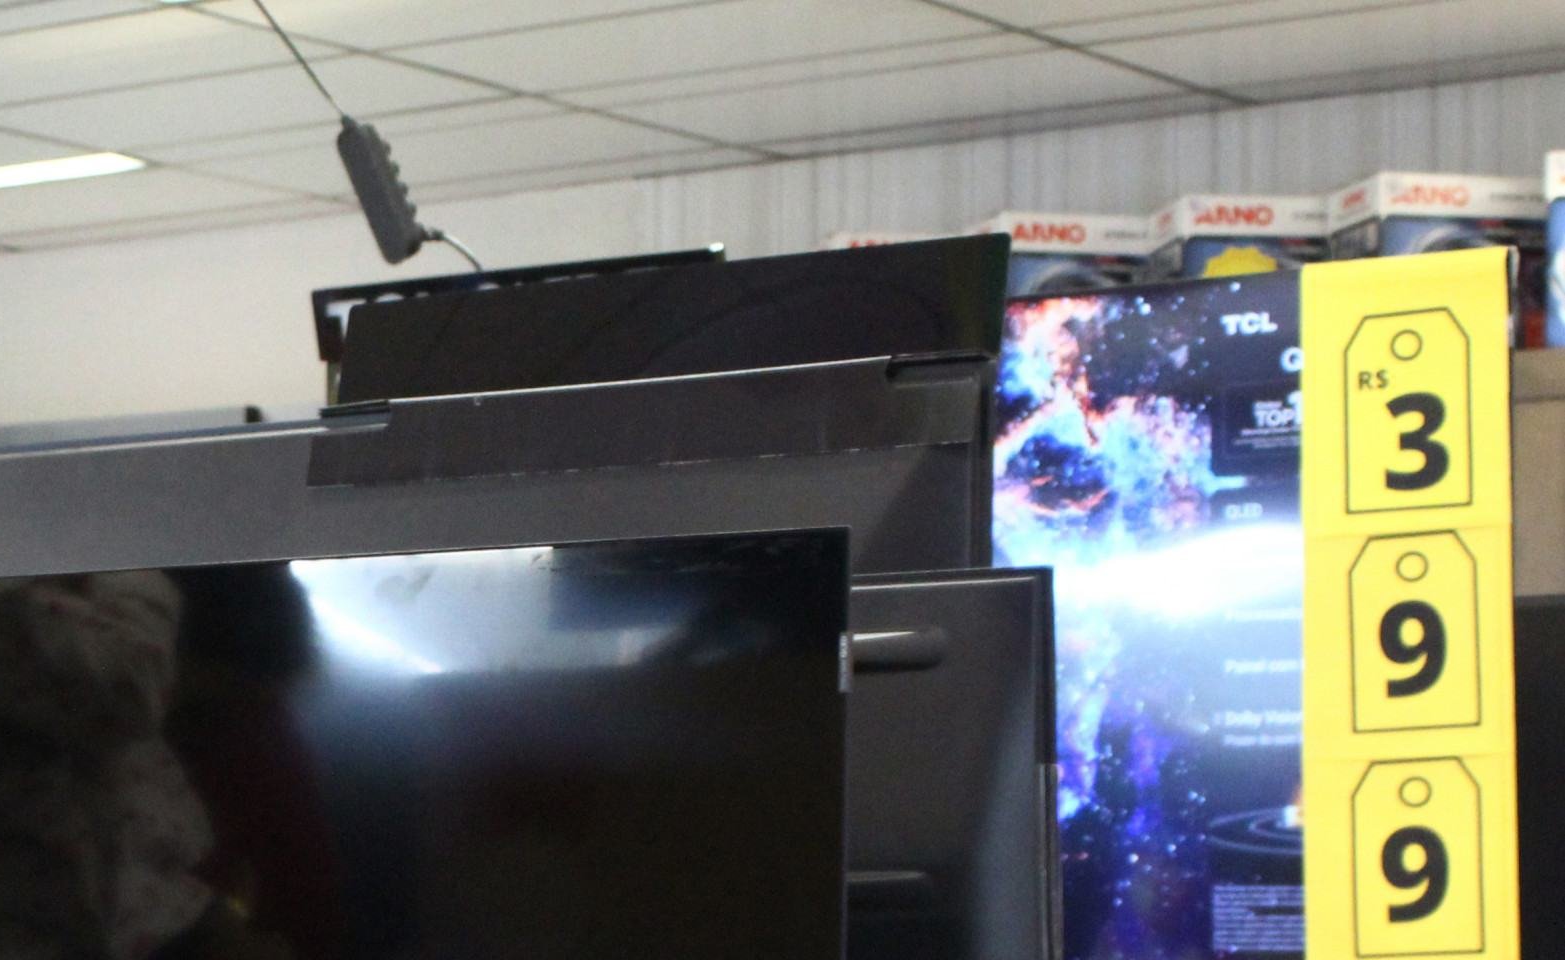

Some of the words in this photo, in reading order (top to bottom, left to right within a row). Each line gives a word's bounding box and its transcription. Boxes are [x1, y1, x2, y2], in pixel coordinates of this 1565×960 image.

[1012, 222, 1086, 245] ARNO
[1220, 312, 1279, 336] TCL
[1385, 391, 1450, 491] 3
[1379, 599, 1448, 699] 9
[1380, 825, 1450, 924] 9
